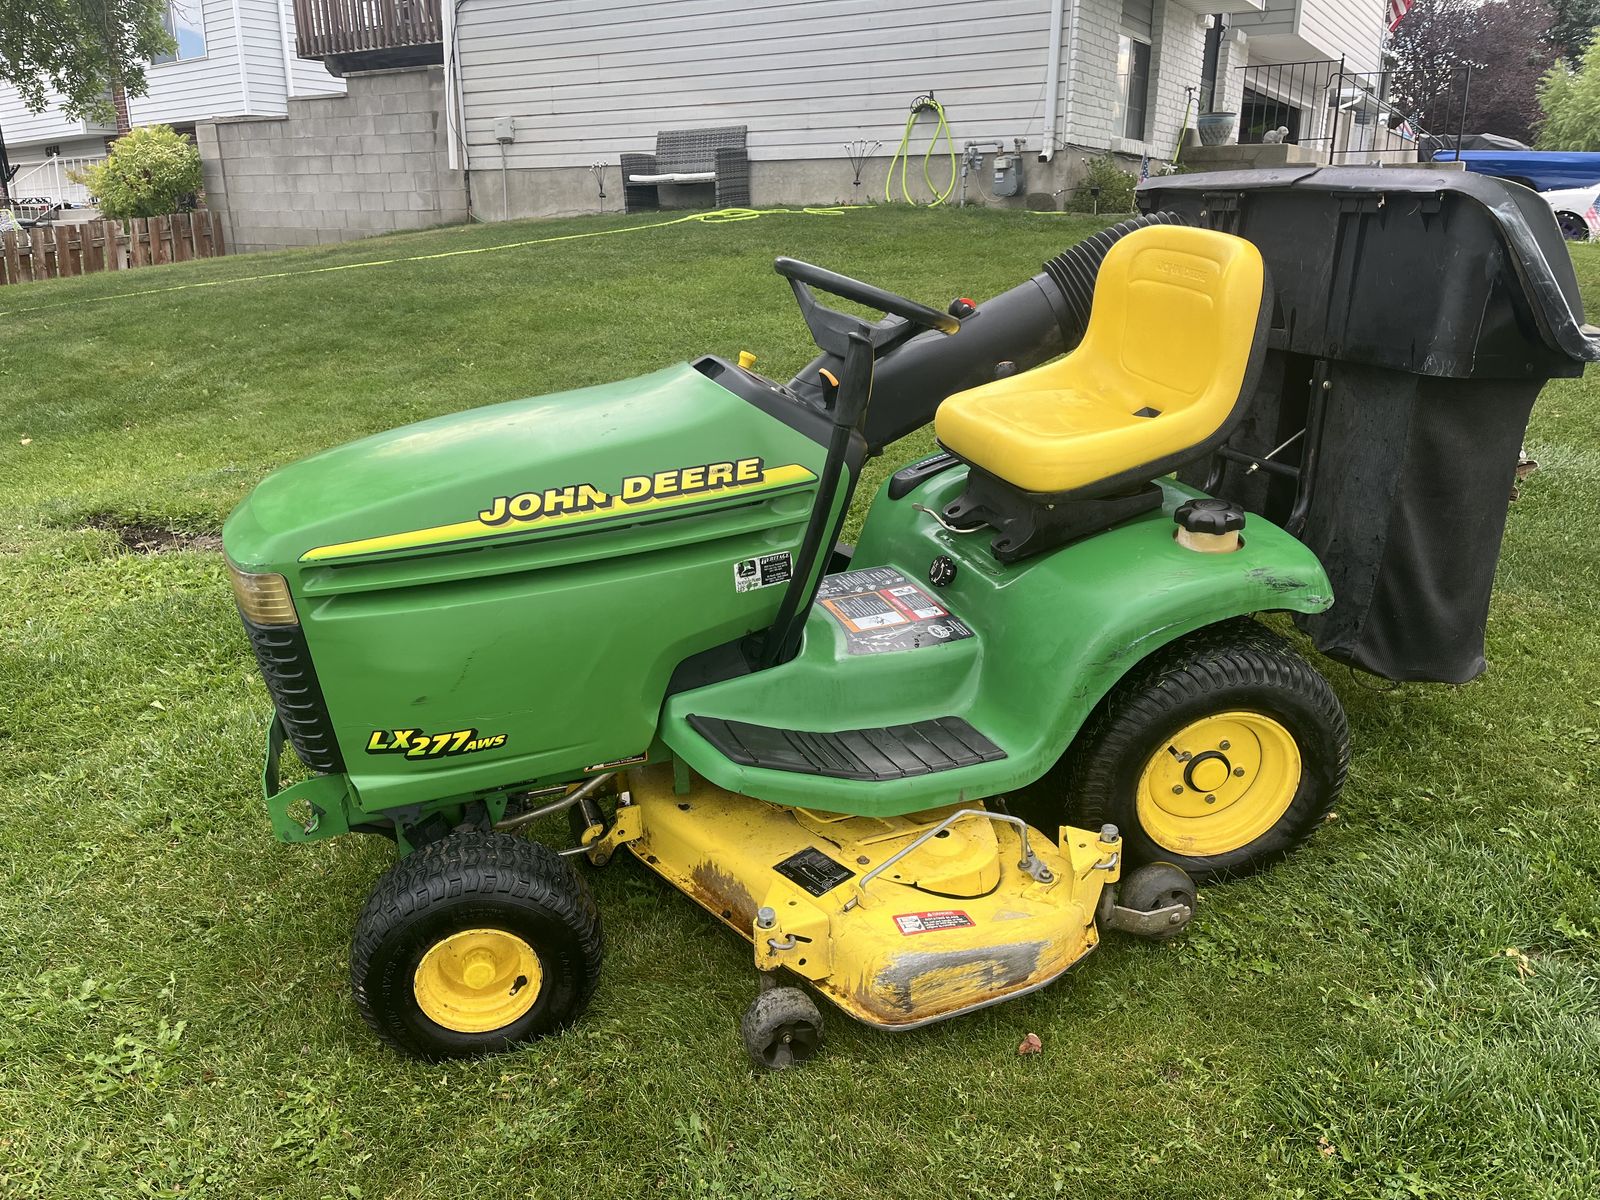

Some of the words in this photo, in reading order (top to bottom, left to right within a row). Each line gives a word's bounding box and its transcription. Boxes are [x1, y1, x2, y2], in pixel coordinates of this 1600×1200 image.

[1156, 260, 1181, 276] JOHN
[1183, 266, 1208, 283] DEERE
[478, 484, 609, 524] JOHN
[621, 457, 762, 502] DEERE
